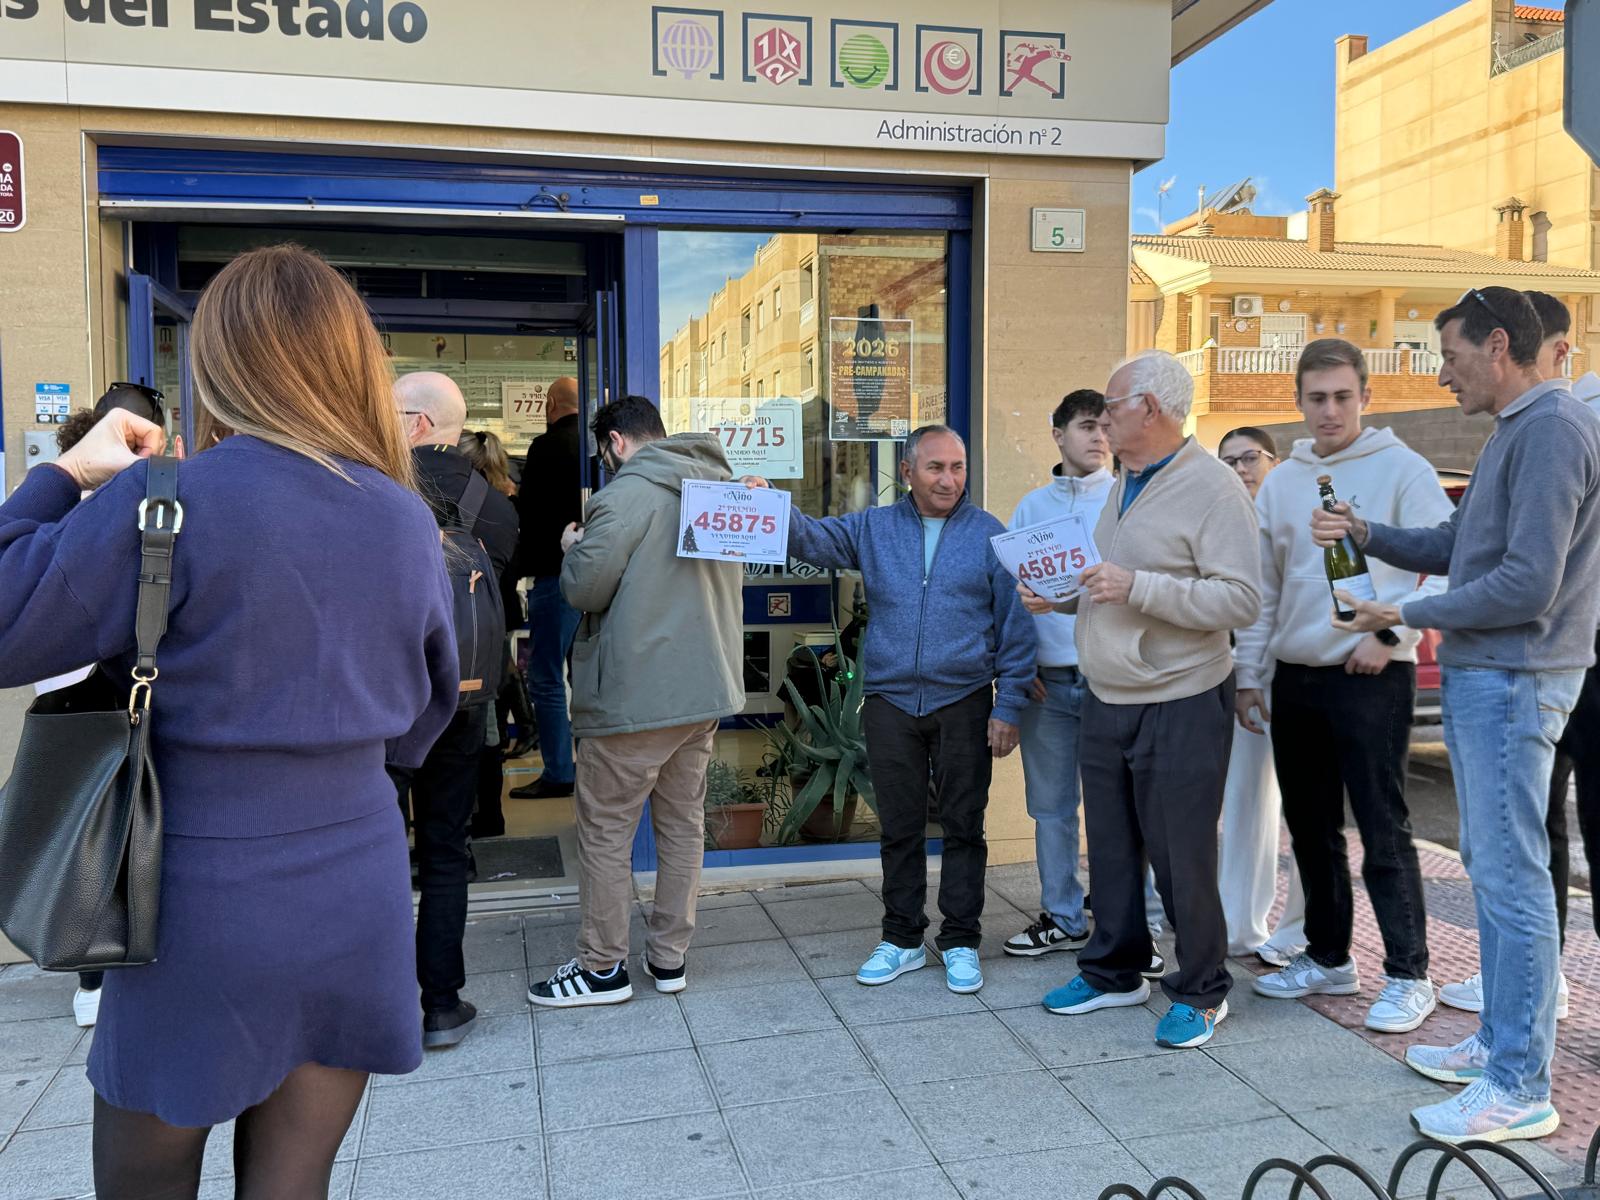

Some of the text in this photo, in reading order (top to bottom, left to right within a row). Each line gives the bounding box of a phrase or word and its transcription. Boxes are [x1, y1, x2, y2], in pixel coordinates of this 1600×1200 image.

[194, 0, 428, 44] Estado
[877, 119, 1062, 146] Administración nº 2
[1052, 227, 1065, 246] 5
[842, 336, 900, 358] 2026
[513, 399, 544, 413] 777
[694, 511, 776, 534] 45875
[1018, 546, 1087, 581] 45875
